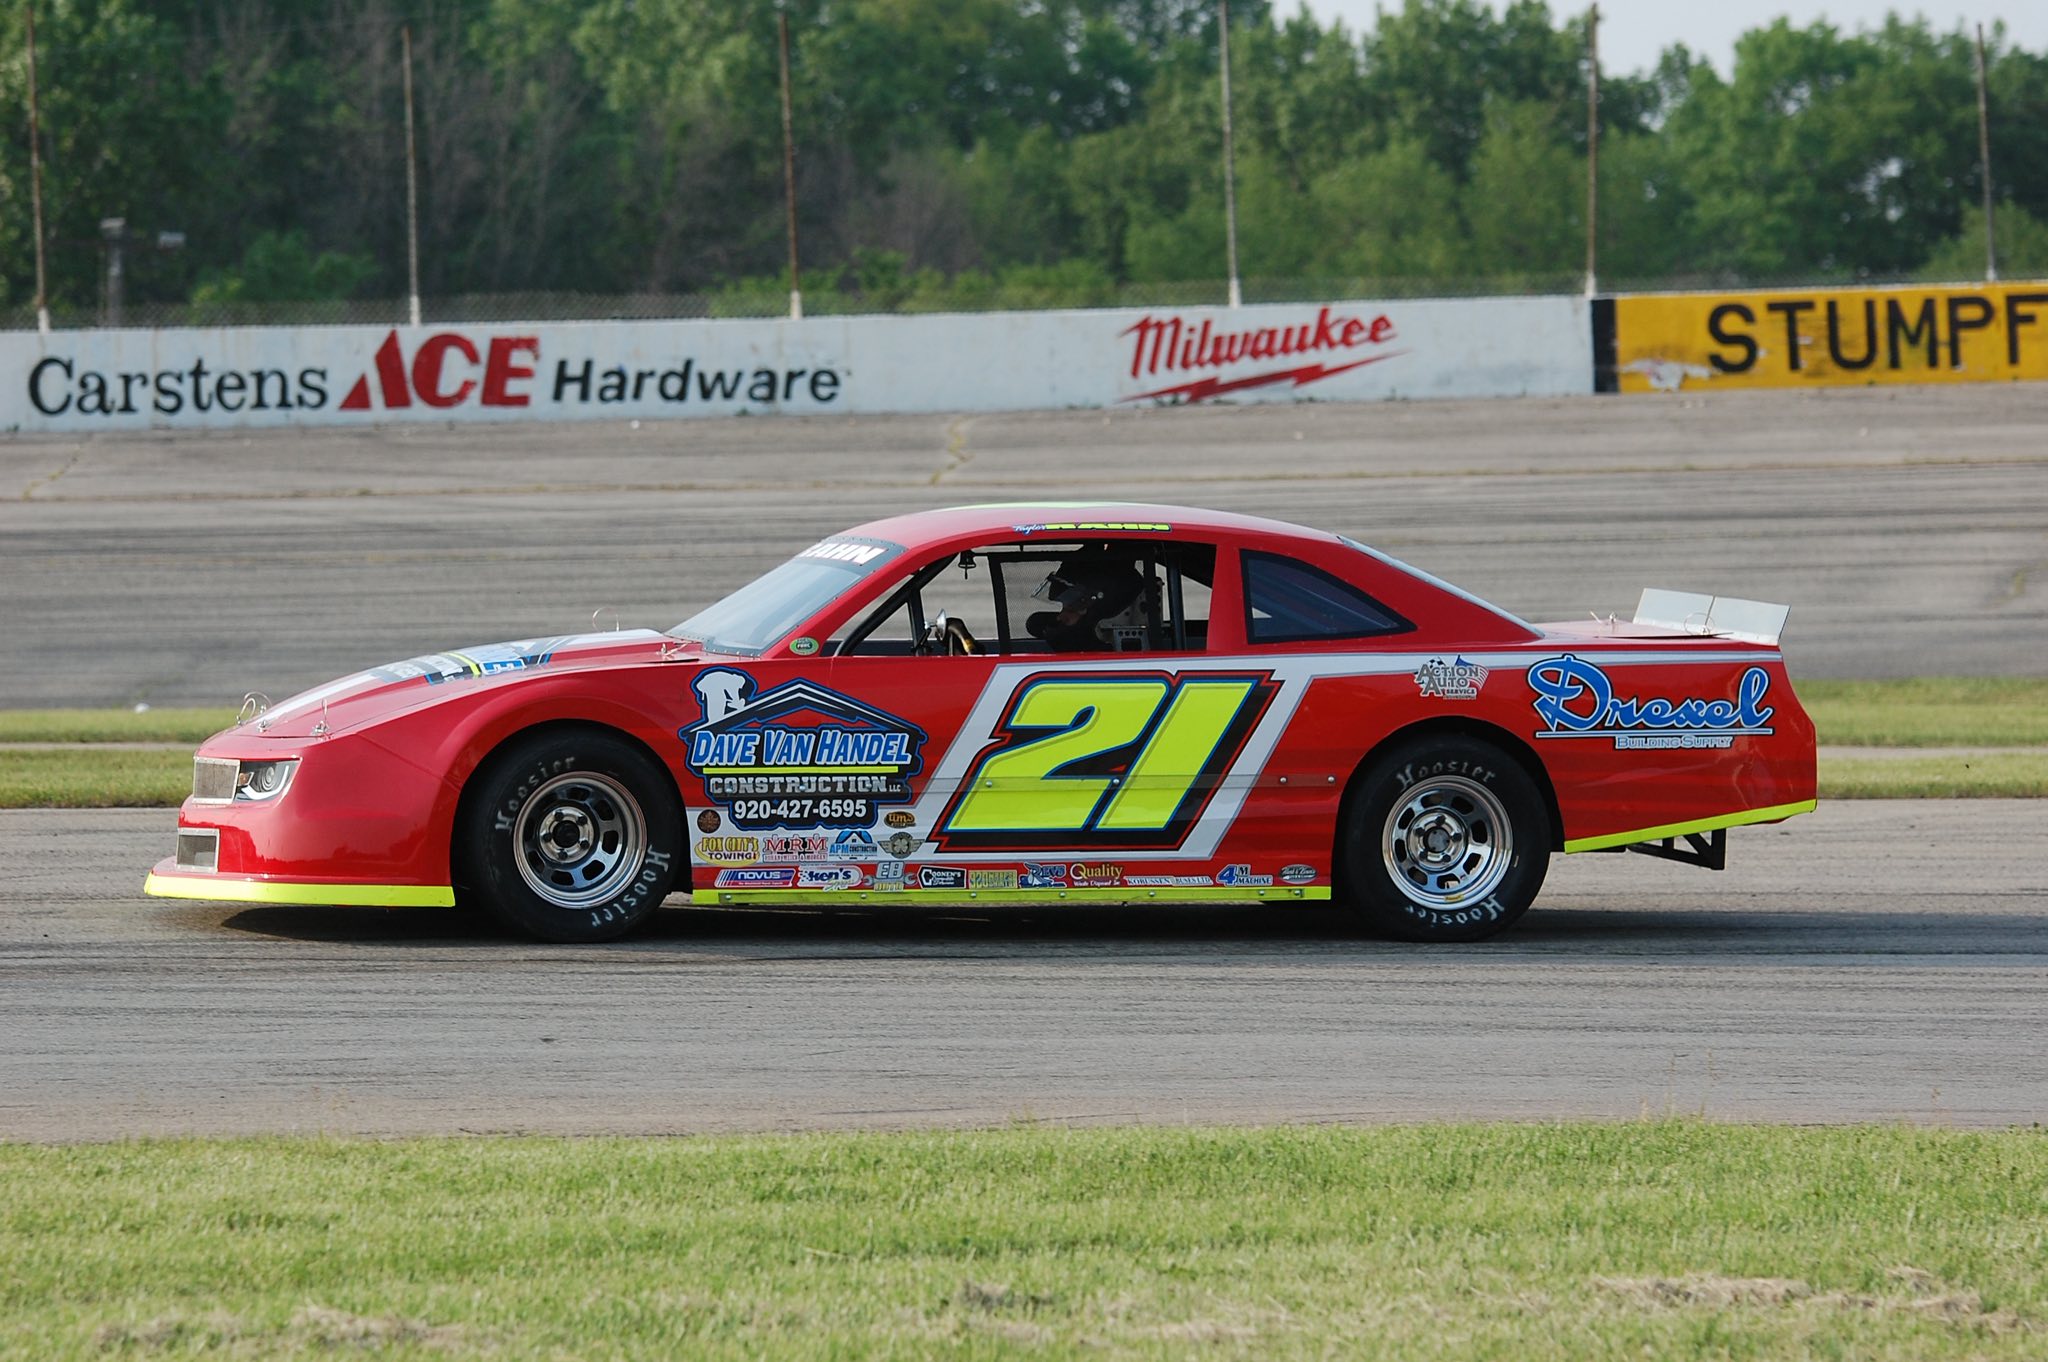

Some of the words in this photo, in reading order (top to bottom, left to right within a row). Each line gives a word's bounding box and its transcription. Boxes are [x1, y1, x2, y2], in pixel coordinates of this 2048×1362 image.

[1118, 306, 1397, 379] Milwaukee
[1709, 294, 2048, 373] STUMPF
[27, 355, 329, 416] Carstens
[338, 328, 541, 411] ACE
[552, 358, 842, 404] Hardware
[1528, 655, 1775, 733] Drexel
[692, 730, 759, 765] DAVE
[762, 730, 815, 765] VAN
[816, 730, 912, 765] HANDEL
[946, 680, 1255, 831] 21
[709, 776, 887, 794] CONSTRUCTION
[734, 799, 867, 820] 920-427-6595
[1070, 863, 1123, 880] Quality
